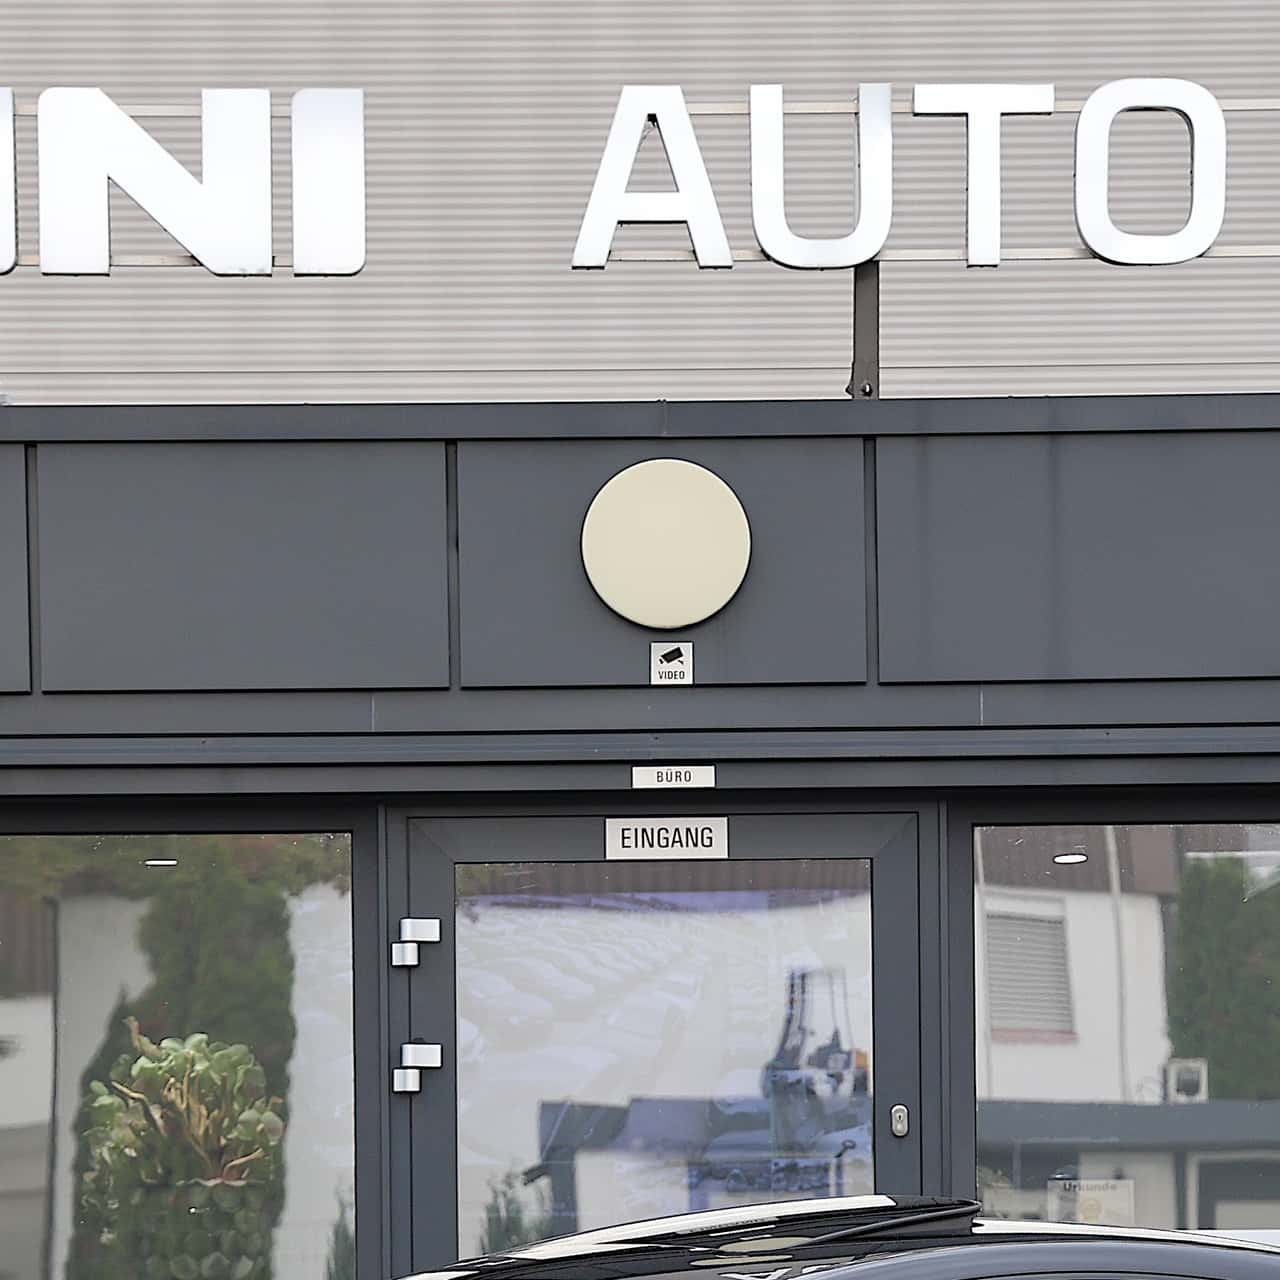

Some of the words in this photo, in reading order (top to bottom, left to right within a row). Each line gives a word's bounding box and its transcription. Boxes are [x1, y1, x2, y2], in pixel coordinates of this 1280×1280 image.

[571, 77, 1227, 271] AUTO
[658, 670, 686, 681] VIDEO
[656, 769, 692, 783] BÜRO
[621, 826, 714, 849] EINGANG
